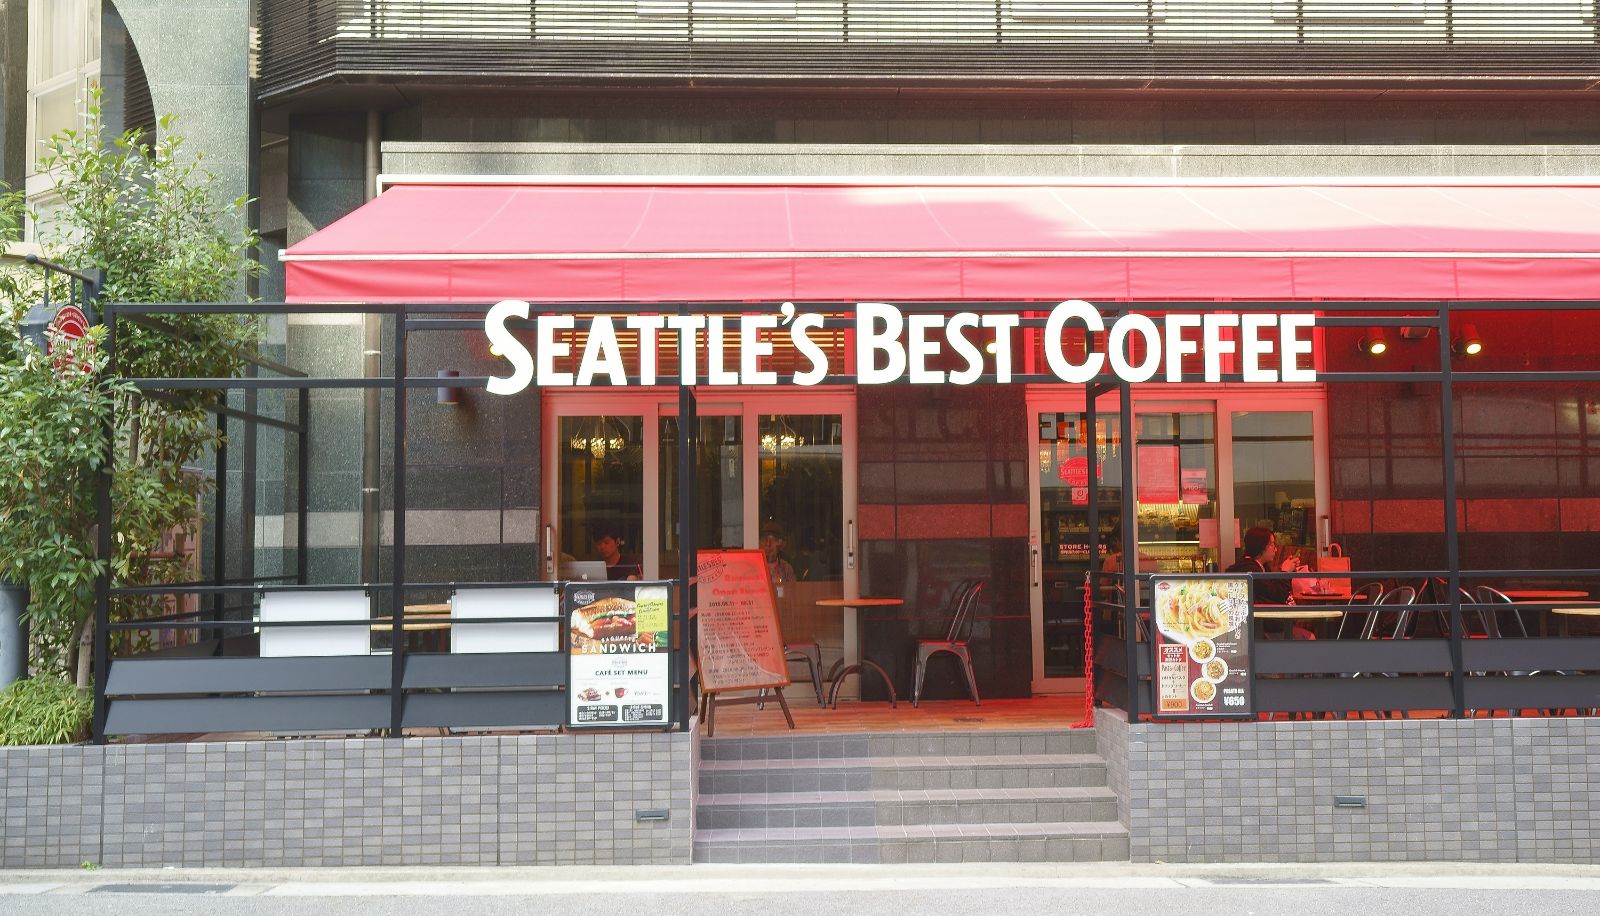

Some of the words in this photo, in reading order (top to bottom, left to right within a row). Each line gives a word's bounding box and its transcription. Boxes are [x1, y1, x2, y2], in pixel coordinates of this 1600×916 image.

[485, 301, 828, 395] SEATTLE'S
[856, 302, 1014, 386] BEST
[1044, 299, 1318, 385] COFFEE
[581, 643, 657, 654] SANDWICH
[1223, 696, 1245, 706] ¥650
